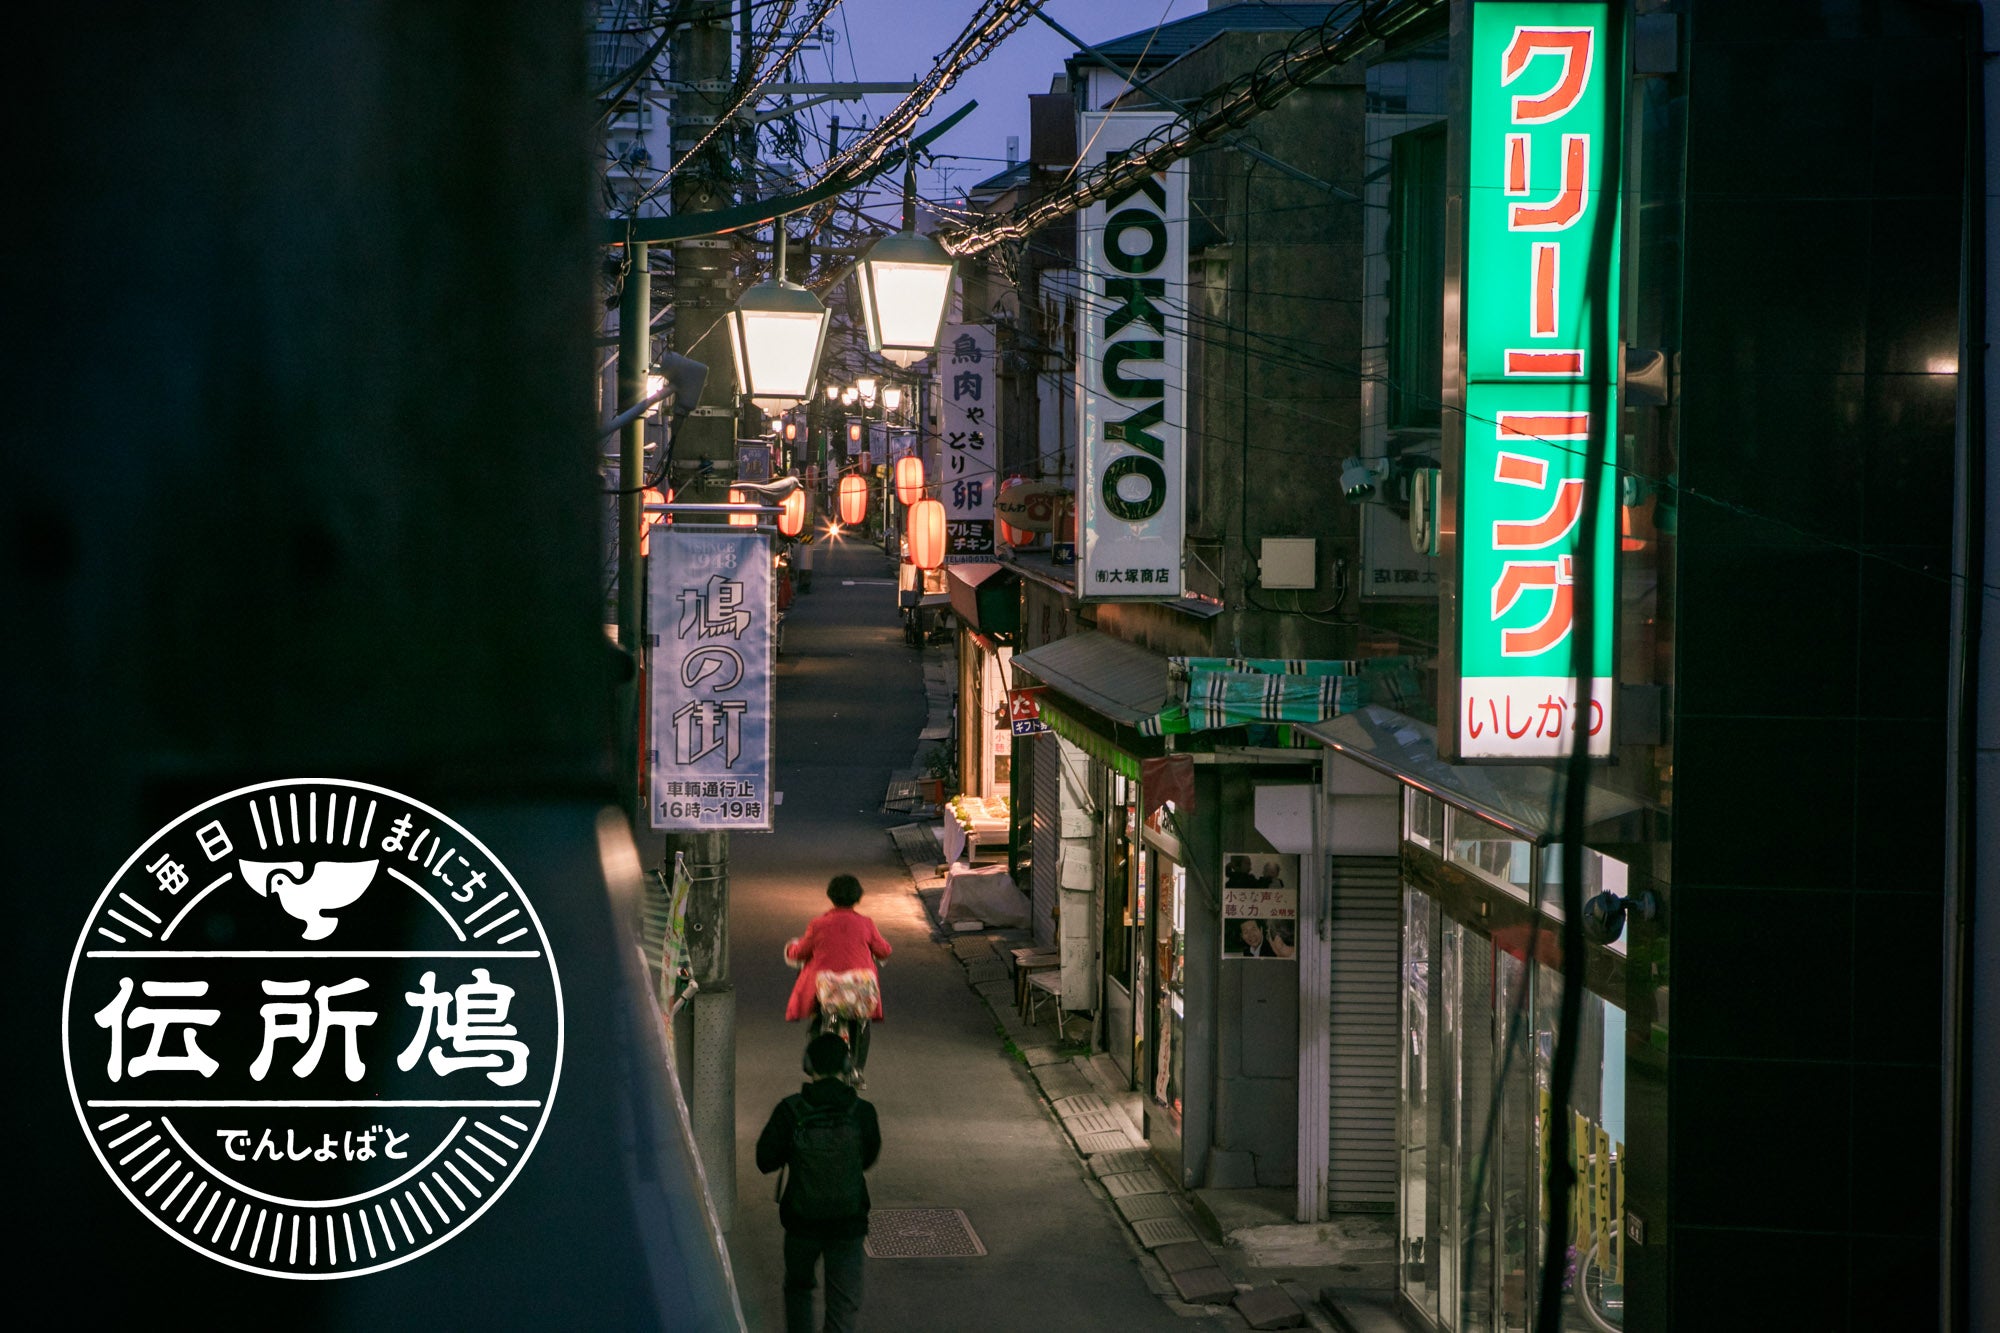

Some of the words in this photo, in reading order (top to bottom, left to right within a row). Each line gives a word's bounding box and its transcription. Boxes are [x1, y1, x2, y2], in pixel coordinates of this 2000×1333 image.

[1102, 151, 1168, 522] KOKUYO
[1491, 25, 1595, 658] クリーニング
[947, 523, 983, 537] マルミ
[953, 537, 992, 551] チキン
[671, 574, 752, 770] 鳩の街
[1225, 904, 1259, 917] 聴く力
